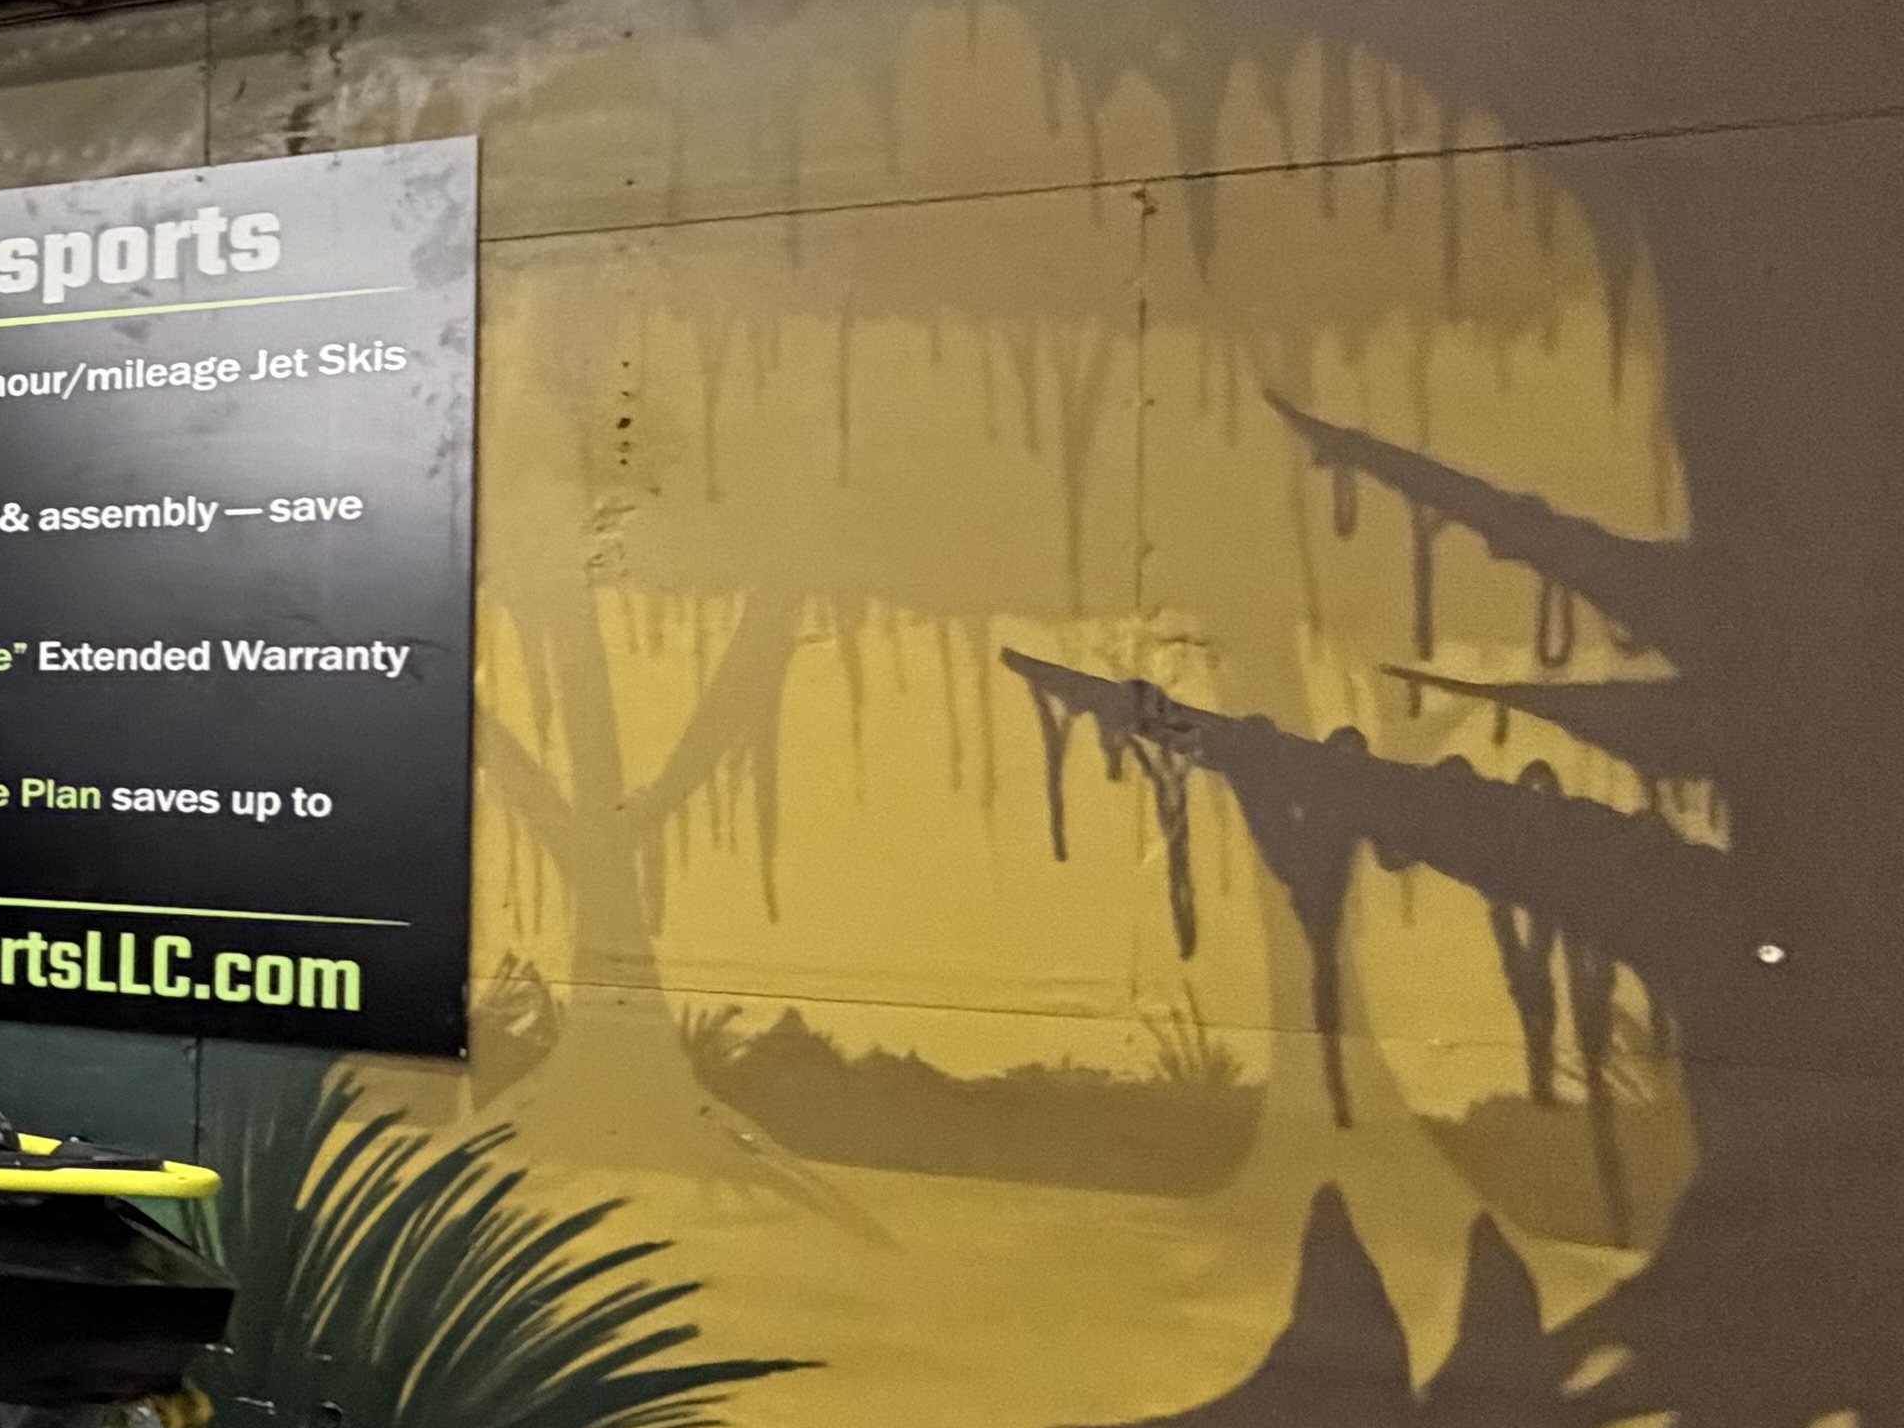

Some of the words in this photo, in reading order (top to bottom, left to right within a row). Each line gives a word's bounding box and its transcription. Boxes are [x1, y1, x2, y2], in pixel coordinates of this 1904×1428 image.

[248, 348, 309, 381] Jet
[318, 340, 408, 376] Skis
[38, 494, 220, 533] assembly
[269, 493, 364, 524] save
[38, 640, 211, 672] Extended
[221, 639, 410, 678] Warranty
[20, 777, 102, 811] Plan
[110, 785, 221, 815] saves
[230, 790, 282, 823] up
[291, 786, 333, 818] to
